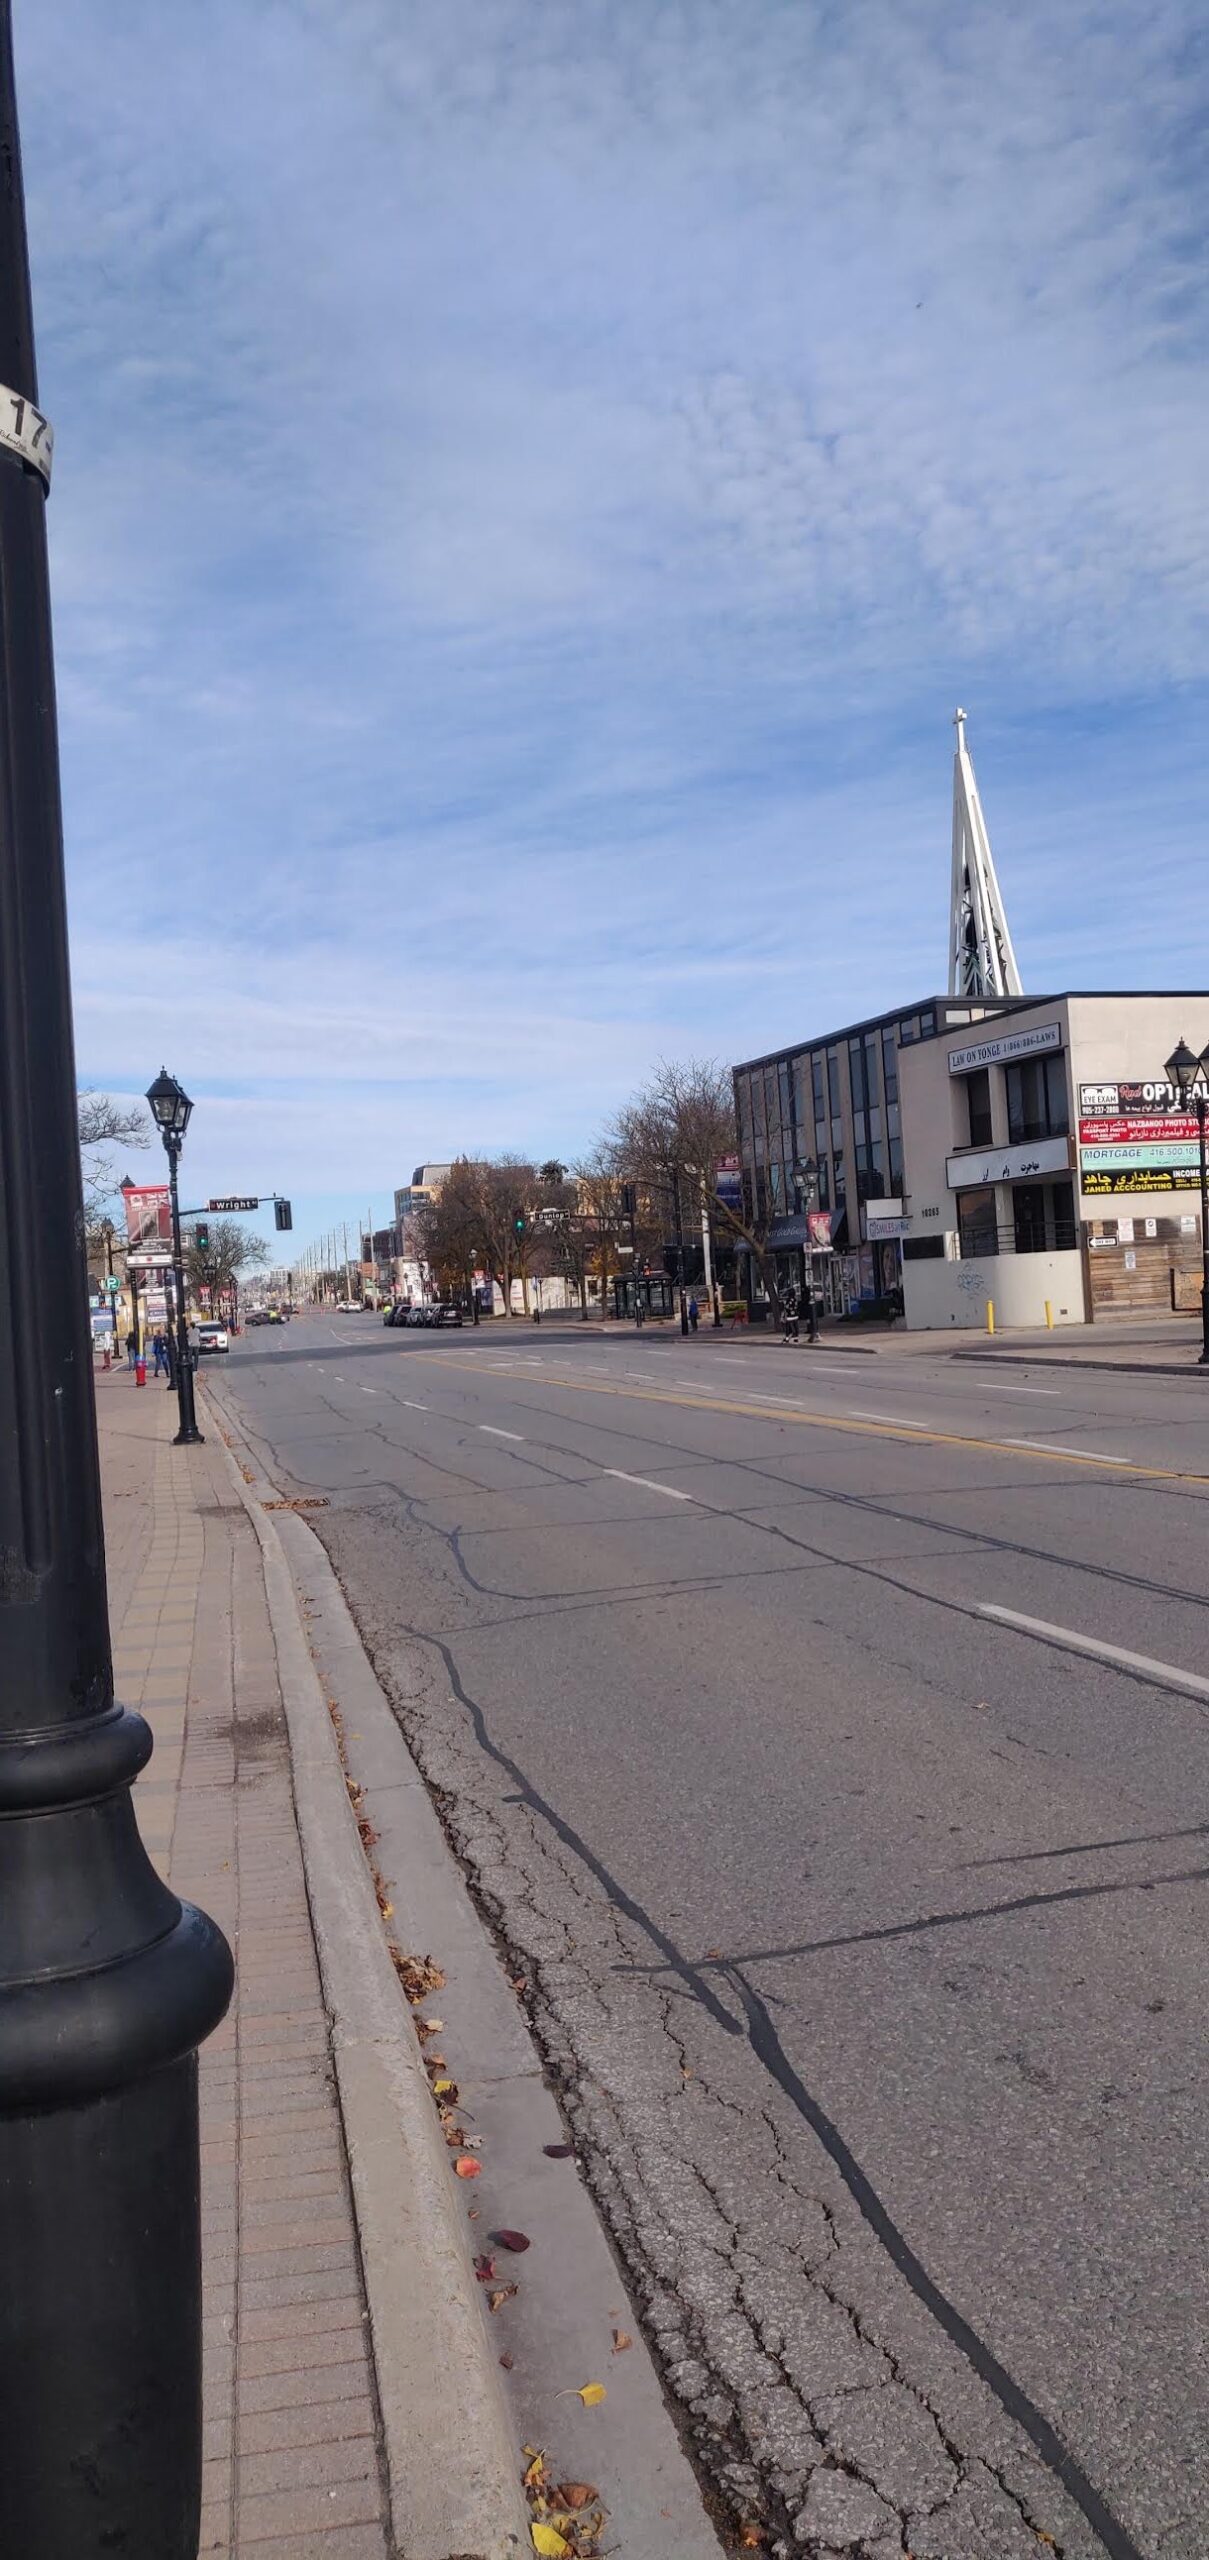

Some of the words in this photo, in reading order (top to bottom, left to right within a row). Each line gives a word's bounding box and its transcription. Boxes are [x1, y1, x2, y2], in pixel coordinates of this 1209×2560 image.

[952, 1053, 965, 1067] LAW
[966, 1051, 977, 1063] ON
[977, 1044, 1001, 1060] YONGE
[1084, 1095, 1096, 1104] EYE
[1097, 1095, 1117, 1103] EXAM
[1164, 1119, 1187, 1127] PHOTO
[1084, 1148, 1142, 1159] MORTGAGE
[1173, 1169, 1201, 1178] INCOME
[1084, 1185, 1112, 1194] JAHED
[216, 1201, 250, 1210] Wright
